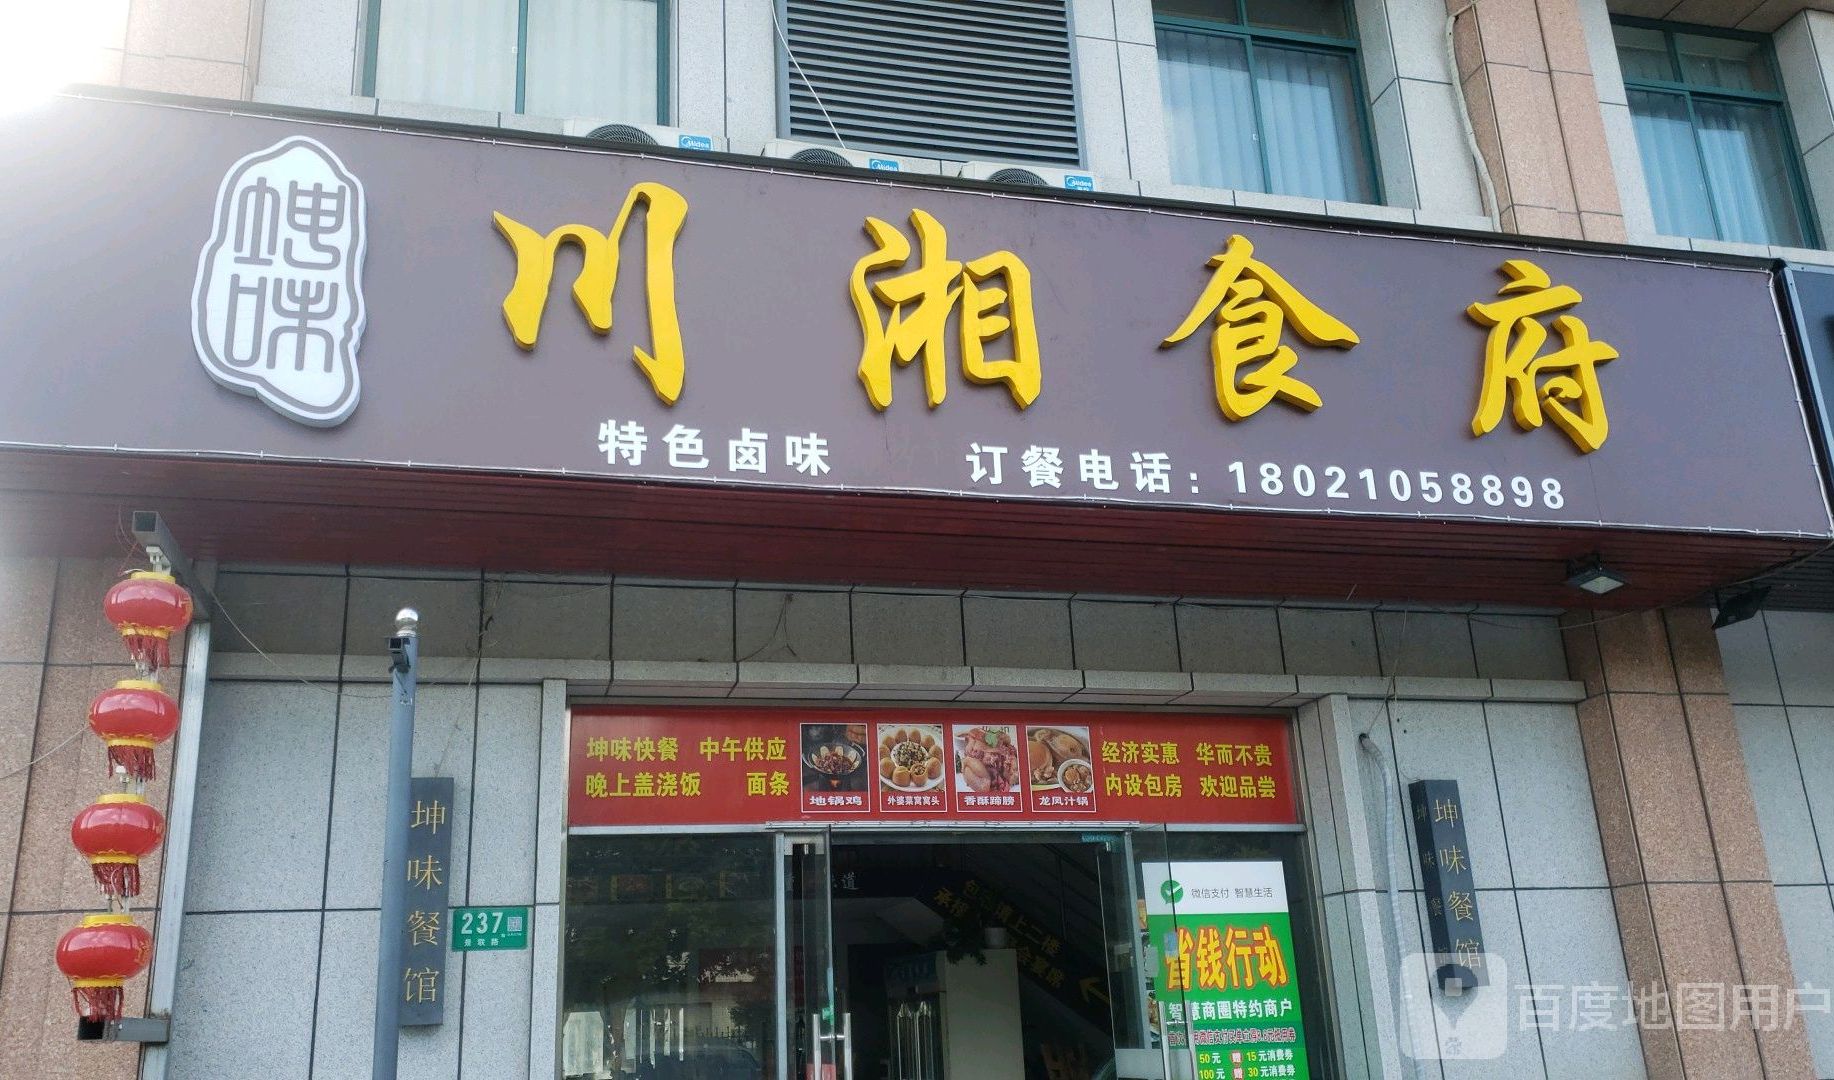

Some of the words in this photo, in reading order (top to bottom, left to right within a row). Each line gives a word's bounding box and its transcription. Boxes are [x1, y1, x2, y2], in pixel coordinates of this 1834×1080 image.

[493, 182, 1619, 453] 川湘食府
[598, 419, 831, 476] 特色卤味
[586, 736, 679, 762] 坤味快餐
[700, 736, 787, 761] 中午供应
[1102, 741, 1180, 765] 经济实惠
[1196, 742, 1273, 767] 华而不贵
[585, 771, 701, 798] 晚上盖浇饭
[746, 770, 790, 796] 面条
[1105, 773, 1183, 798] 内设包房
[1200, 775, 1276, 799] 欢迎品尝
[810, 795, 862, 806] 地锅鸡
[1191, 887, 1230, 899] 微信支付
[1235, 887, 1274, 899] 智慧生活
[1433, 799, 1481, 969] 坤味餐馆
[404, 800, 446, 1003] 坤味餐馆
[461, 912, 503, 934] 237
[1166, 926, 1287, 989] 省钱行动
